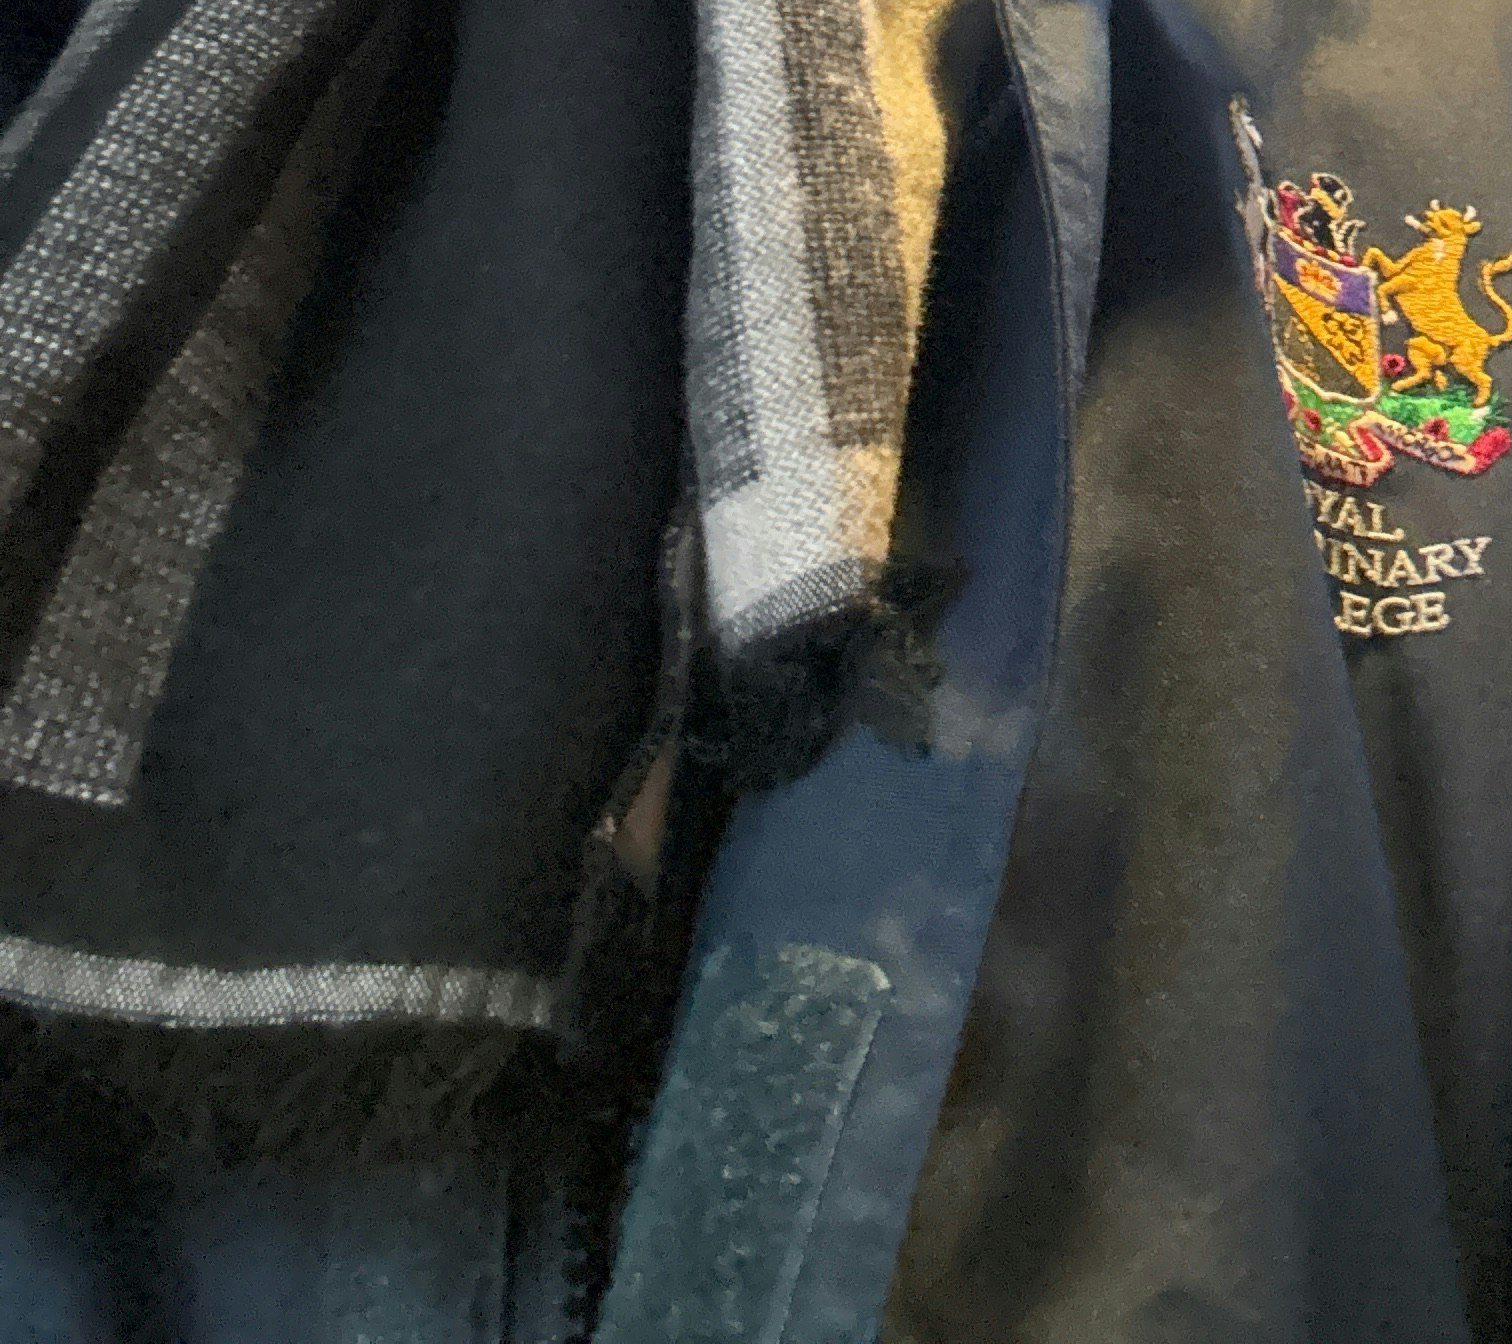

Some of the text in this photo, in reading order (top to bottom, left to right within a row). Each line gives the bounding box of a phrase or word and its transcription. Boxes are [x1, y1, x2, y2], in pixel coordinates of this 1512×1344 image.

[1303, 479, 1405, 542] YAL
[1313, 529, 1494, 587] INARY
[1333, 590, 1451, 639] EGE
